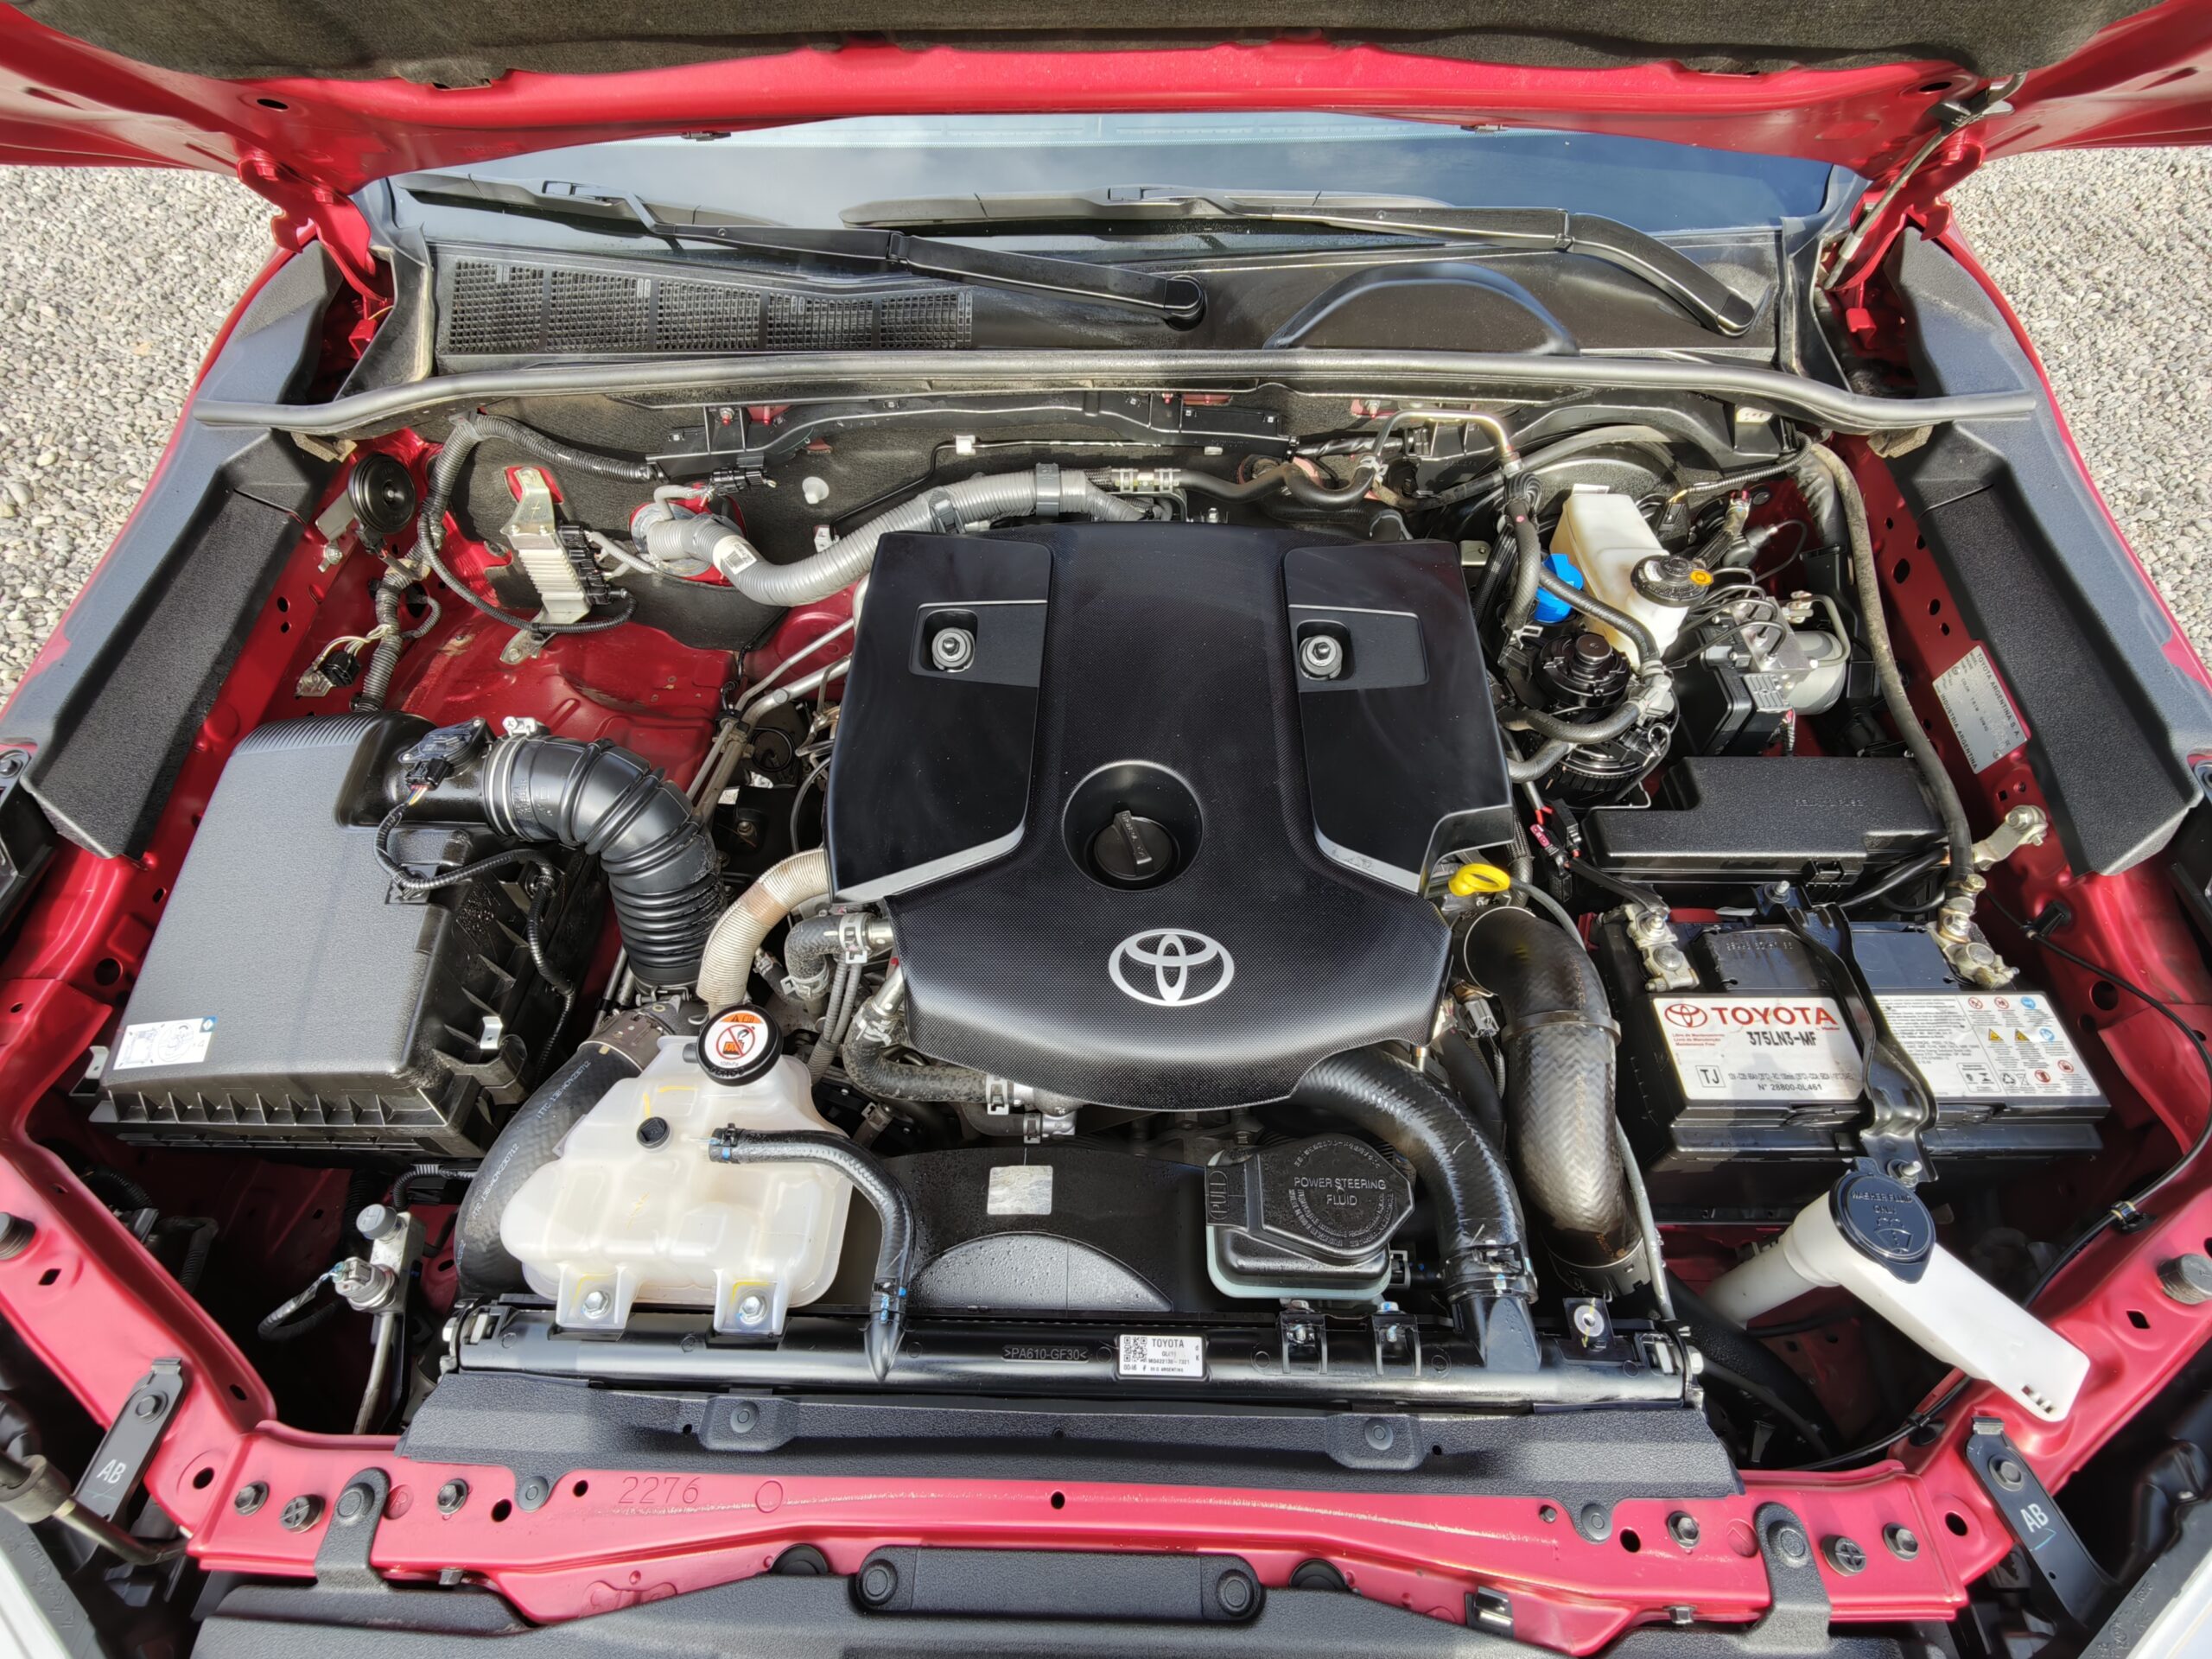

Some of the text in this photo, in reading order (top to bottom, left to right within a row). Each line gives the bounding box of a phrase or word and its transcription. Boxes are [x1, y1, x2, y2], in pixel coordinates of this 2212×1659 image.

[1976, 653, 1992, 680] TOYOTA
[1990, 681, 2012, 721] ARGENTINA
[1941, 693, 1959, 729] INDUSTRIA
[1957, 730, 1979, 769] ARGENTINA
[1711, 1006, 1839, 1026] TOYOTA
[1746, 1031, 1817, 1046] 375LN3-MF
[1700, 1069, 1719, 1084] TJ
[1294, 1177, 1387, 1190] POWER STEERING
[1210, 1182, 1227, 1214] PULL
[1326, 1194, 1357, 1206] FLUID
[1852, 1192, 1913, 1204] WASHER FLUID
[1873, 1205, 1897, 1215] ONLY
[1152, 1338, 1185, 1348] TOYOTA
[1004, 1347, 1088, 1361] >PA610-GF30<
[97, 1459, 127, 1484] AB
[618, 1476, 702, 1504] 2276
[2020, 1503, 2049, 1533] AB
